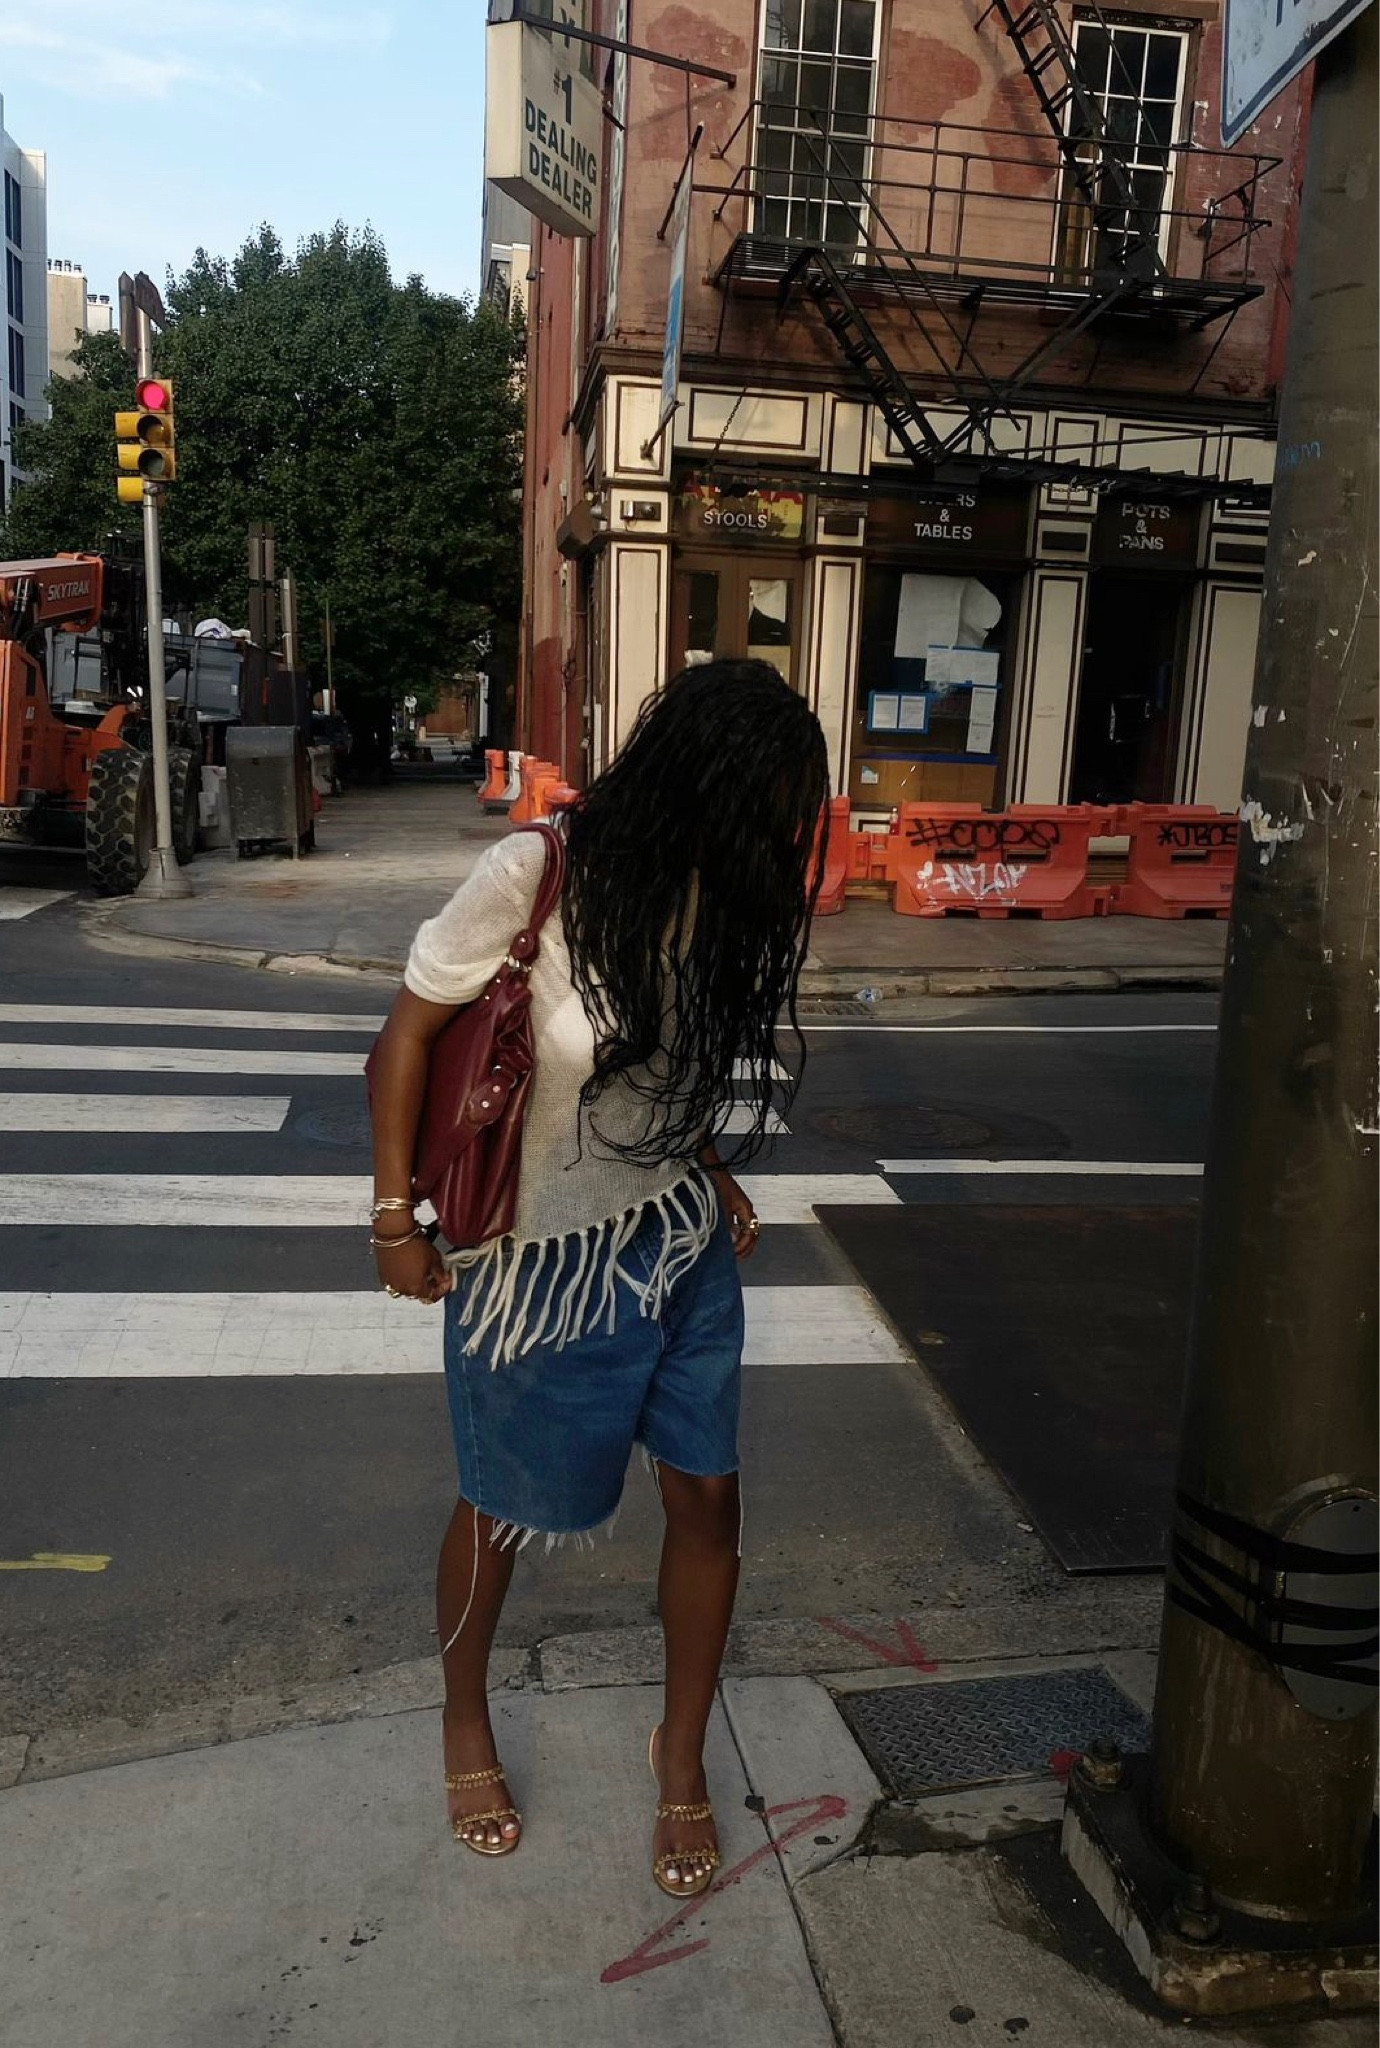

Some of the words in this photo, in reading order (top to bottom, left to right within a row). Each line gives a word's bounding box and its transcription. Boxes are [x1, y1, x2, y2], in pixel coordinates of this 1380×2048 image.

[553, 67, 572, 126] #1
[525, 96, 598, 187] DEALING
[529, 142, 593, 220] DEALER
[939, 508, 950, 522] &
[1121, 501, 1171, 519] POTS
[703, 511, 768, 529] STOOLS
[1135, 519, 1148, 534] &
[914, 522, 973, 541] TABLES
[1119, 534, 1165, 550] PANS
